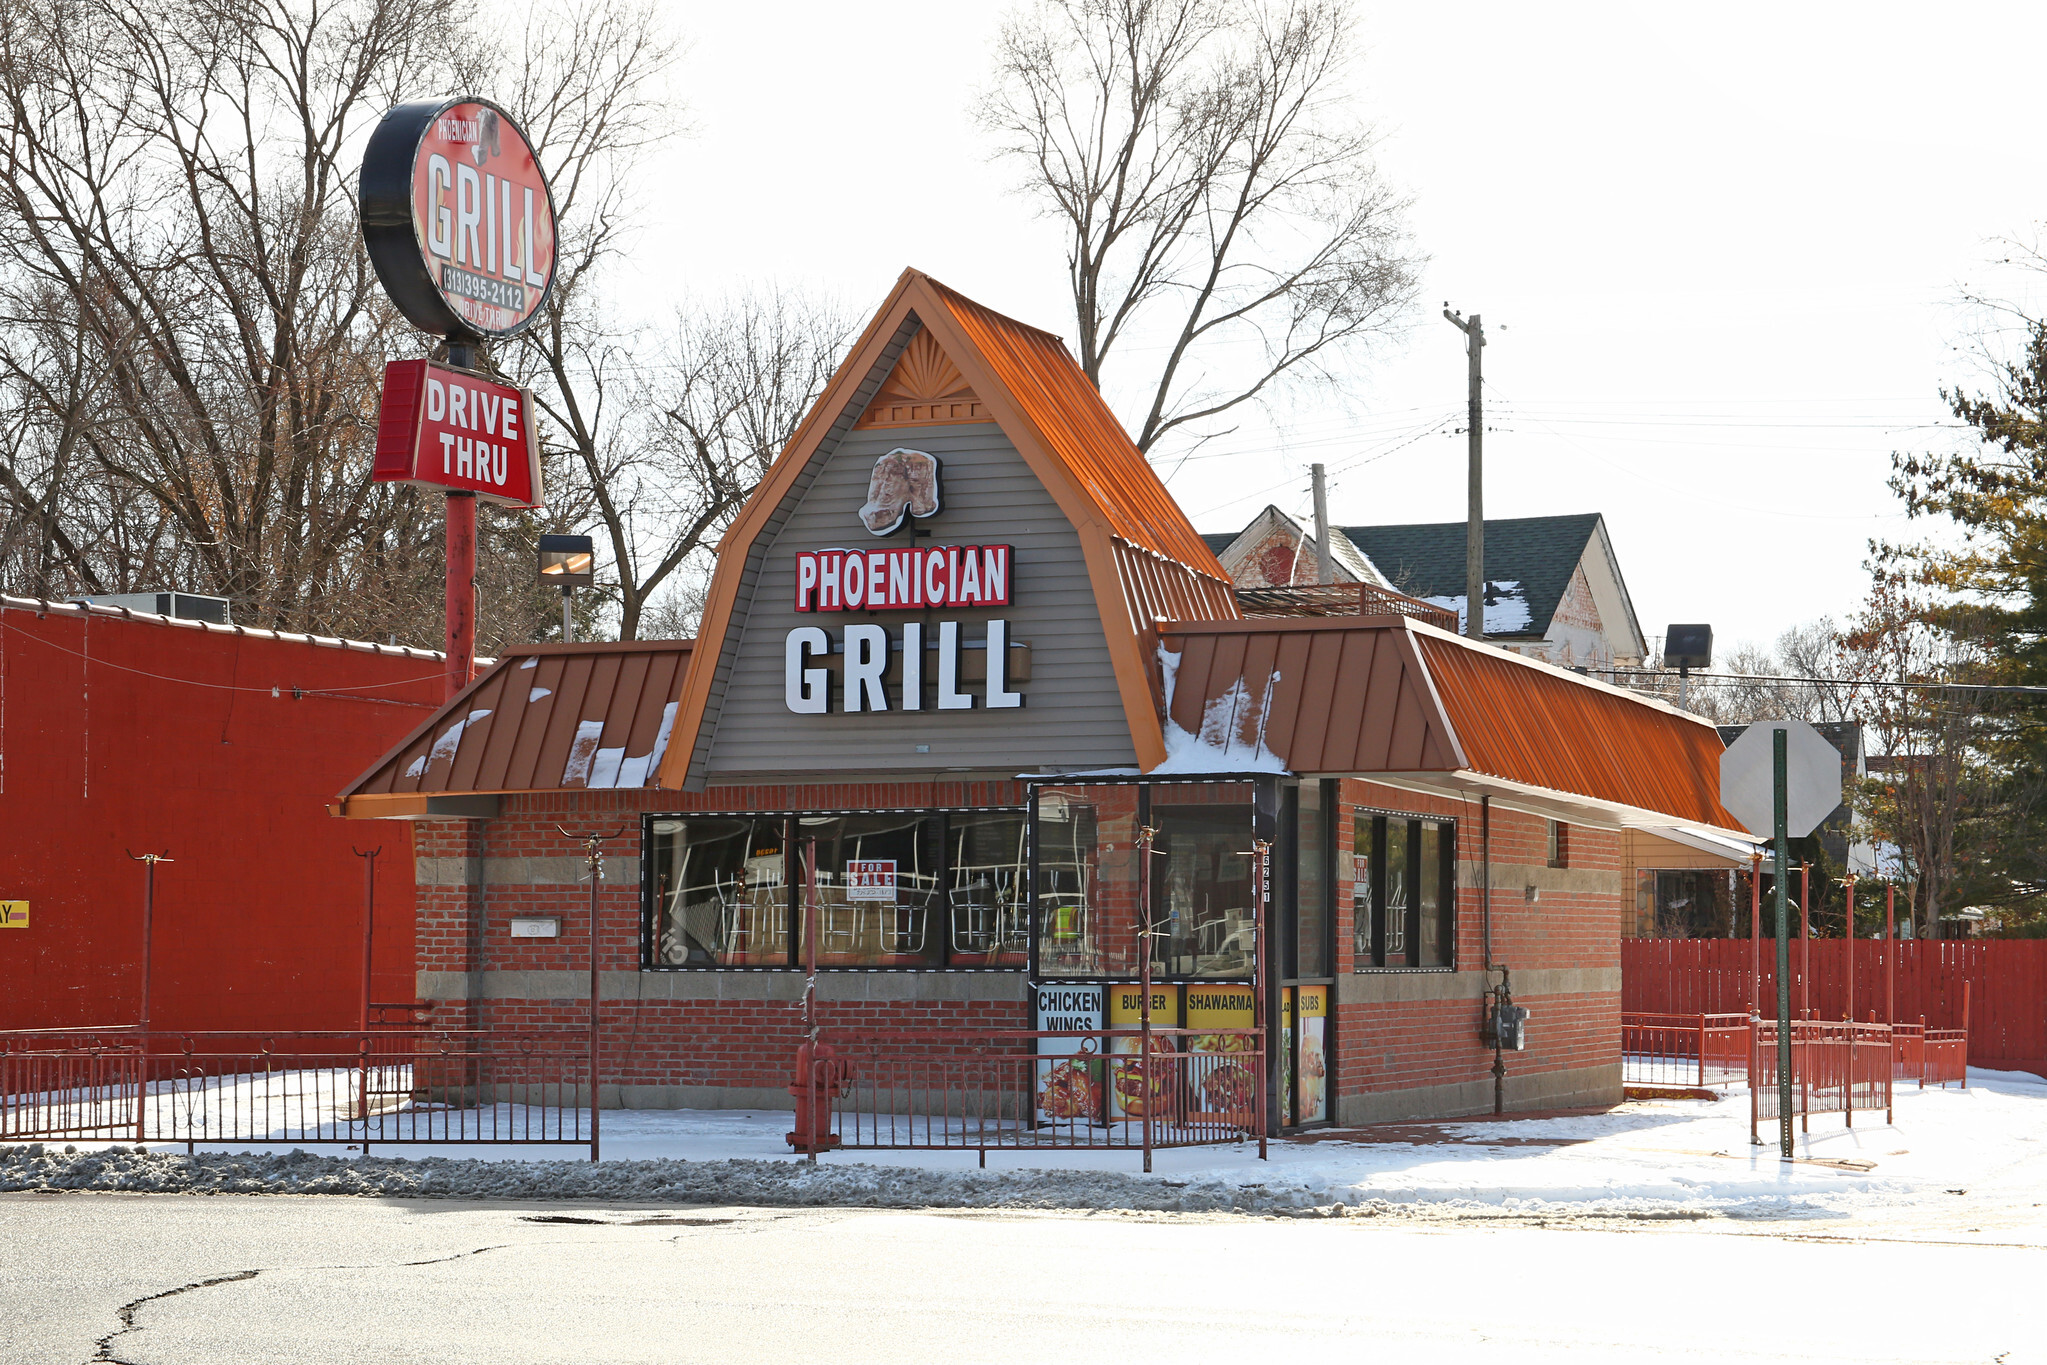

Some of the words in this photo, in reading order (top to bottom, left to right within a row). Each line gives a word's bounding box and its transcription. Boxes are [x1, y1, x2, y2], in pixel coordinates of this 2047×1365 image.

[438, 118, 477, 142] PHOENICIAN
[427, 152, 544, 289] GRILL
[443, 267, 522, 310] (313)395-2112
[459, 299, 483, 321] DRIVE
[427, 378, 518, 441] DRIVE
[439, 431, 508, 486] THRU
[798, 547, 1006, 609] PHOENICIAN
[785, 618, 1024, 715] GRILL
[850, 871, 893, 886] SALE
[861, 863, 882, 872] FOR
[1038, 991, 1101, 1012] CHICKEN
[1122, 994, 1167, 1010] BURER
[1188, 994, 1253, 1011] SHAWARMA
[1300, 995, 1319, 1011] SUBS
[1046, 1016, 1093, 1031] WINGS
